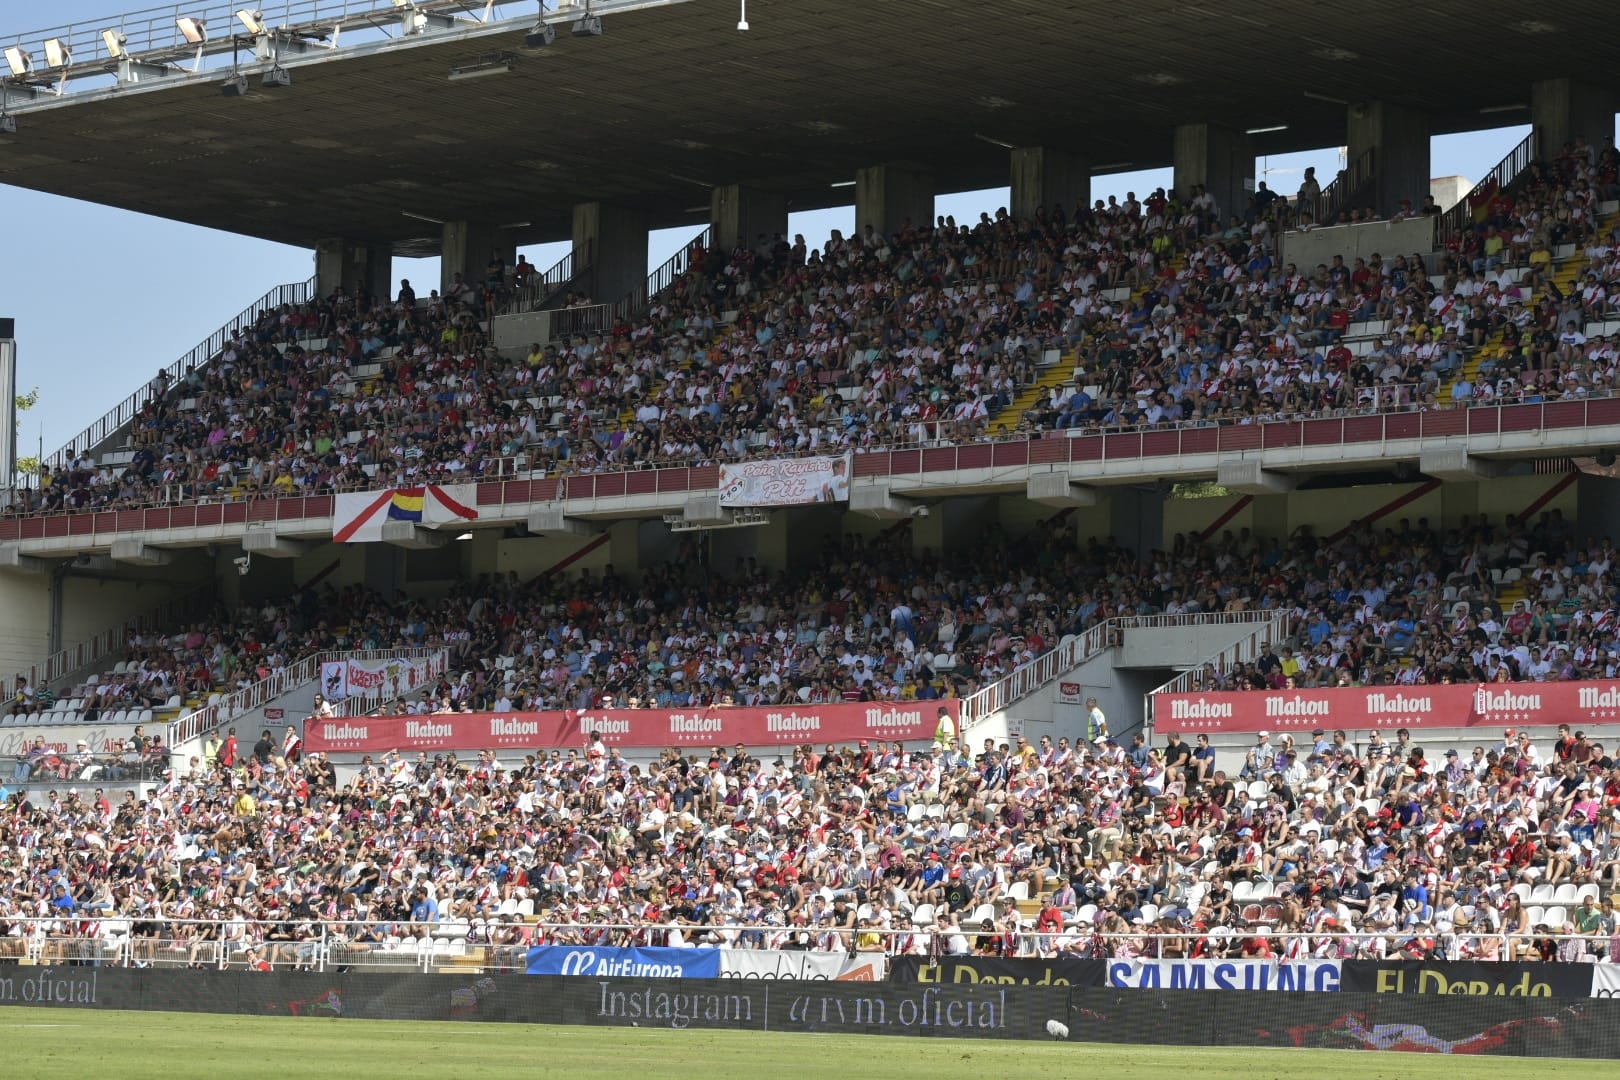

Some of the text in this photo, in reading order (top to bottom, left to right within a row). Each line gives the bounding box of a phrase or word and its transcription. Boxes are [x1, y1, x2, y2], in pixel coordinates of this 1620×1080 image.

[763, 479, 807, 498] Piti
[1171, 698, 1232, 718] Mahou
[1265, 695, 1329, 716] Mahou
[1366, 693, 1431, 714] Mahou
[324, 706, 921, 740] Mahou Mahou Mahou Mahou Mahou Mahou Mahou
[1110, 963, 1340, 992] SAMSUNG
[597, 982, 752, 1028] Instagram
